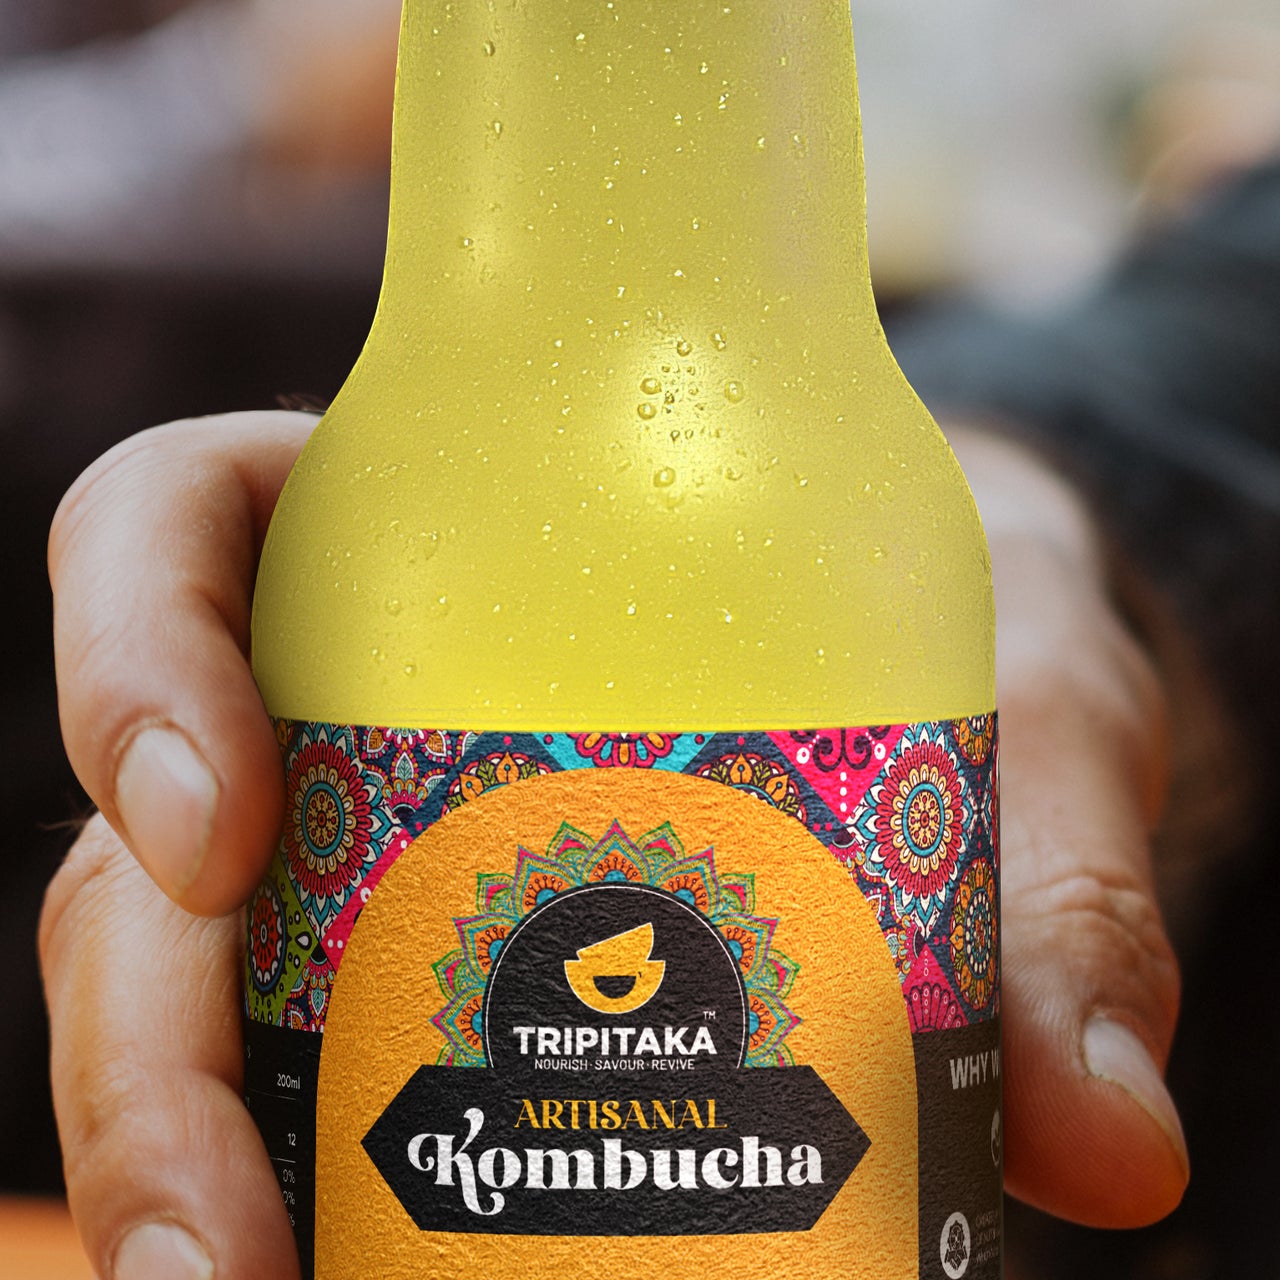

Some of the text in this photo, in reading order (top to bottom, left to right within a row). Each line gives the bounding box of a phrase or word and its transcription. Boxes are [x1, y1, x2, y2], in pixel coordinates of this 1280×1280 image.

[702, 1010, 716, 1020] TM
[513, 1026, 717, 1056] TRIPITAKA
[534, 1058, 695, 1070] NOURISH SAVOUR REVIVE
[949, 1051, 988, 1090] WHY
[276, 1073, 301, 1091] 200ml
[513, 1098, 728, 1131] ARTISANAL
[287, 1132, 297, 1147] 12
[407, 1107, 825, 1216] Kombucha
